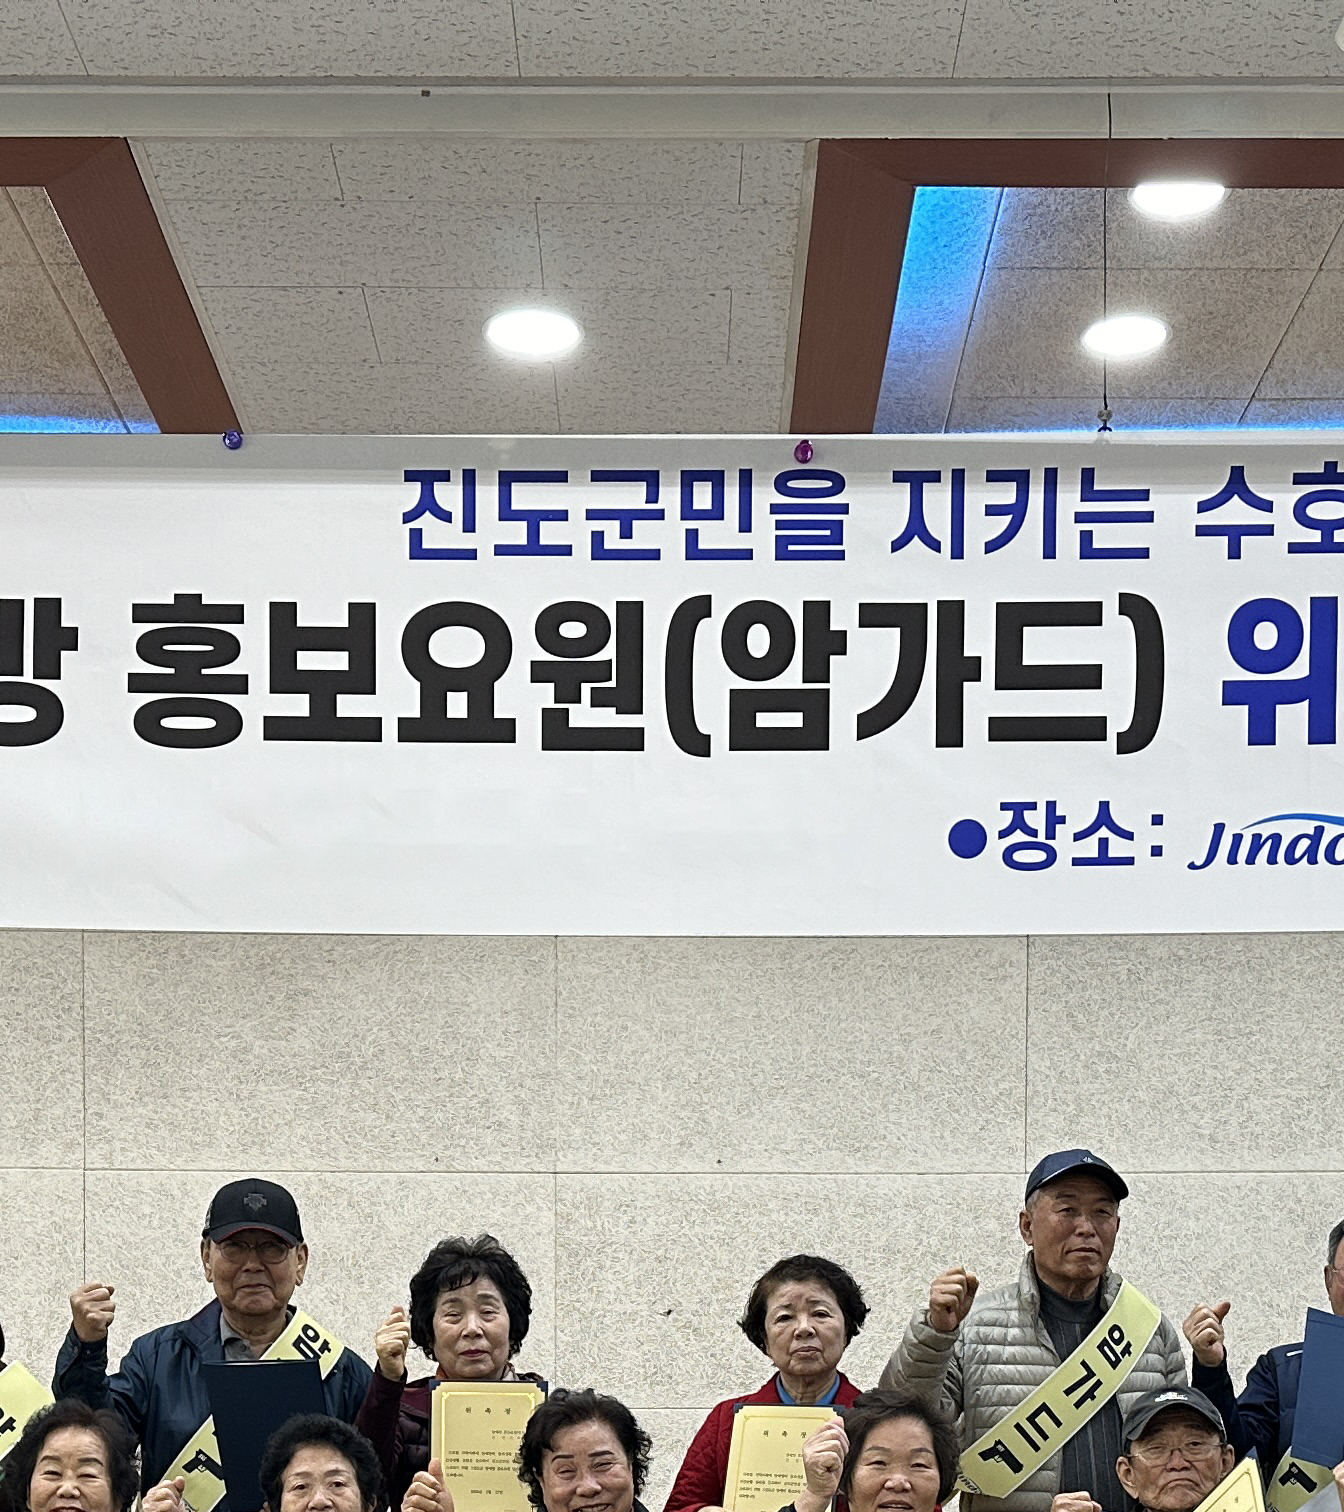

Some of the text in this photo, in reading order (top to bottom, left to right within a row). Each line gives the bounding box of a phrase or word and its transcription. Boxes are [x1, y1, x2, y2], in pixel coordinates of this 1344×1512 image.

[403, 464, 849, 561] 진도군민을
[891, 466, 1154, 560] 지키는
[128, 593, 1164, 757] 홍보요원(암가드)
[1013, 1322, 1133, 1453] 암가드
